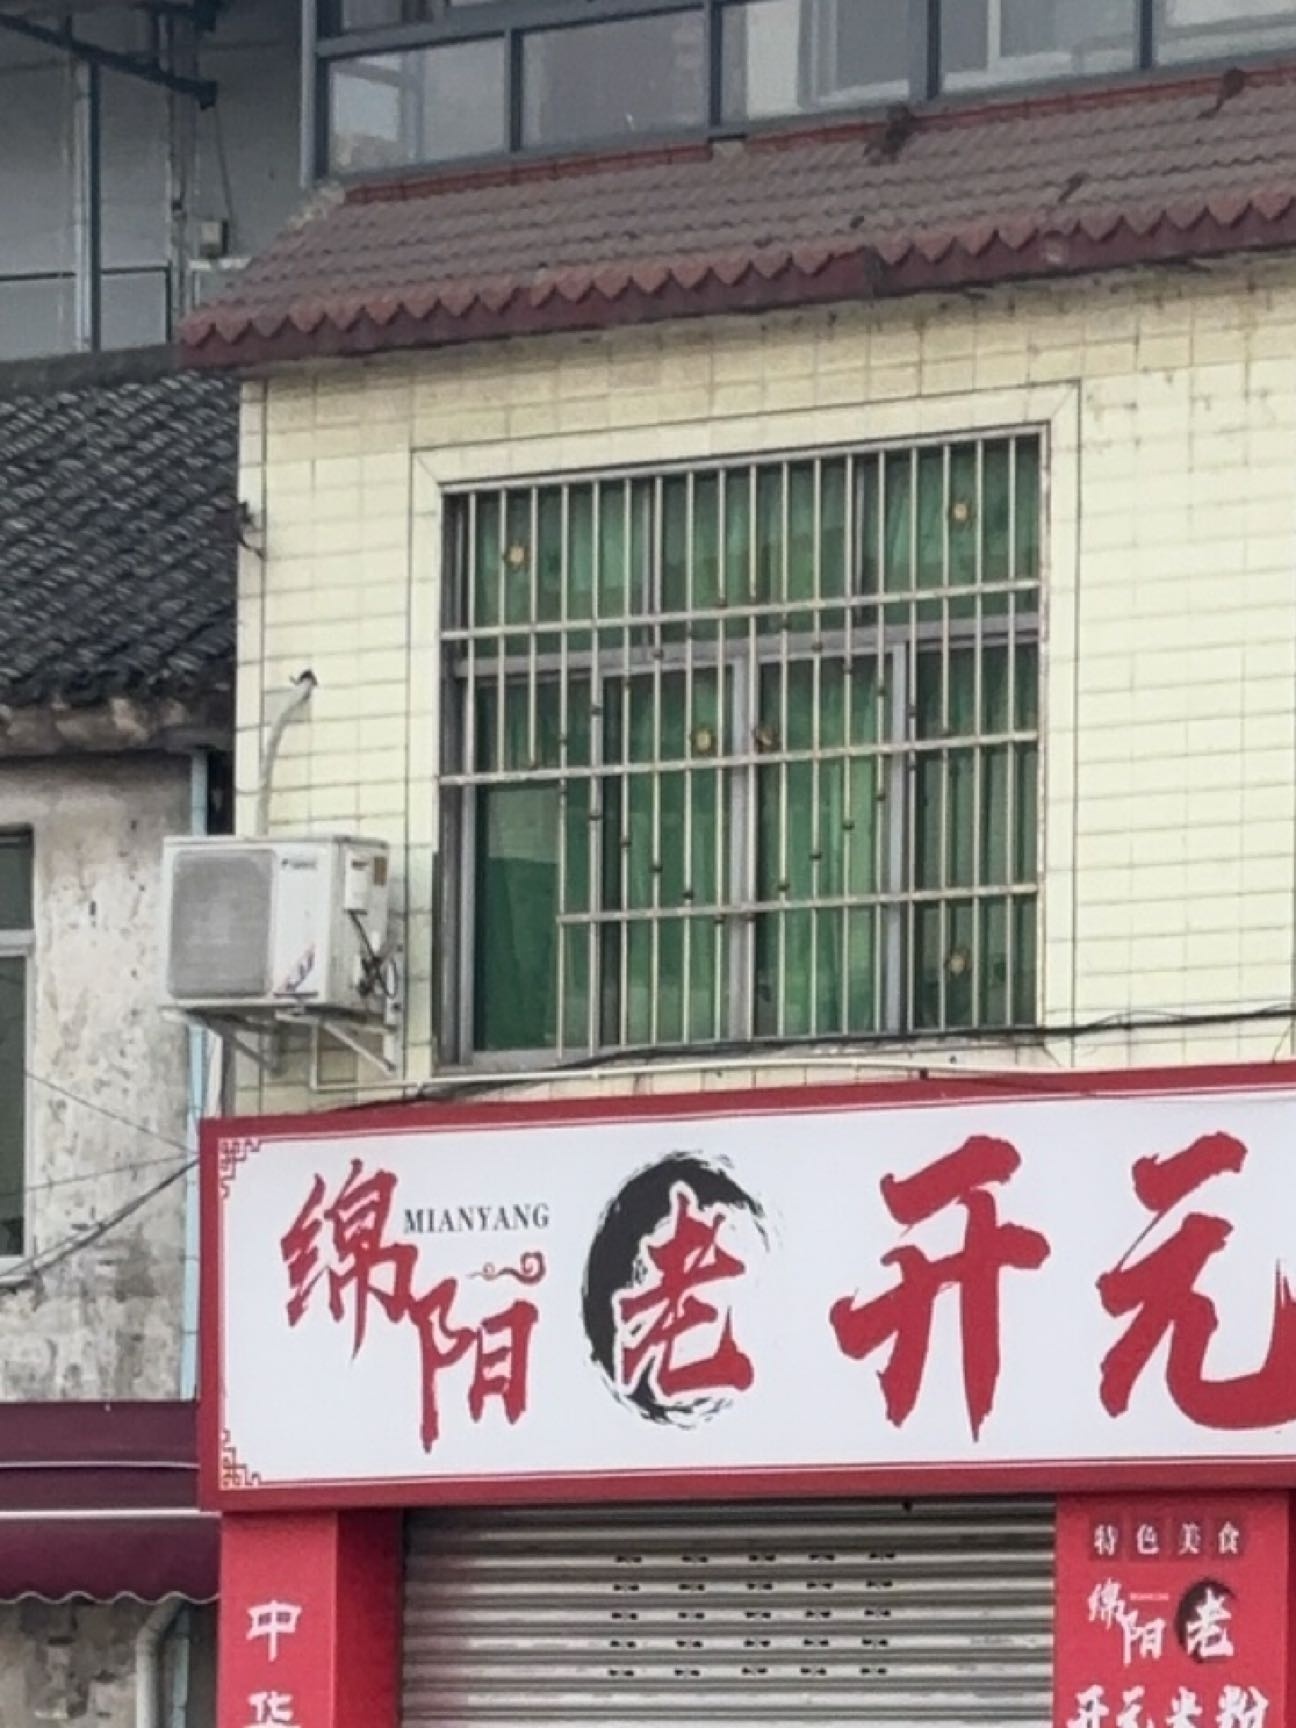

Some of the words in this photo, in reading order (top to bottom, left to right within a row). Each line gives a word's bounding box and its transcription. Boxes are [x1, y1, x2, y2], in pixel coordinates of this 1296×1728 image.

[403, 1202, 550, 1234] MIANYANG
[281, 1158, 538, 1454] 绵阳
[1094, 1520, 1240, 1556] 特色美食
